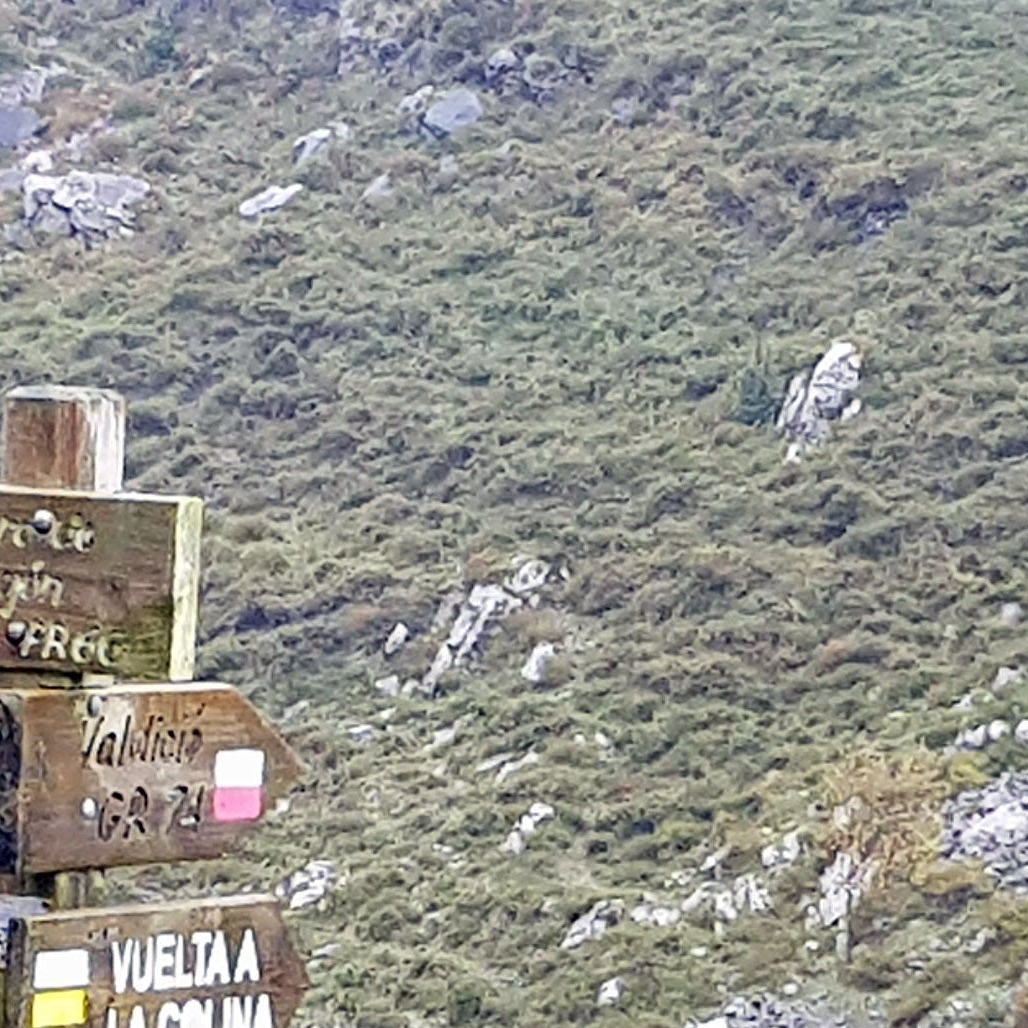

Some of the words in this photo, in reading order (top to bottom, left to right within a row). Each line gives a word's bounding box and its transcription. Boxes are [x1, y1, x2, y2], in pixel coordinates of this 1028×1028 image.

[98, 786, 148, 842] GR
[110, 930, 230, 994] VUELTA
[233, 928, 260, 983] A
